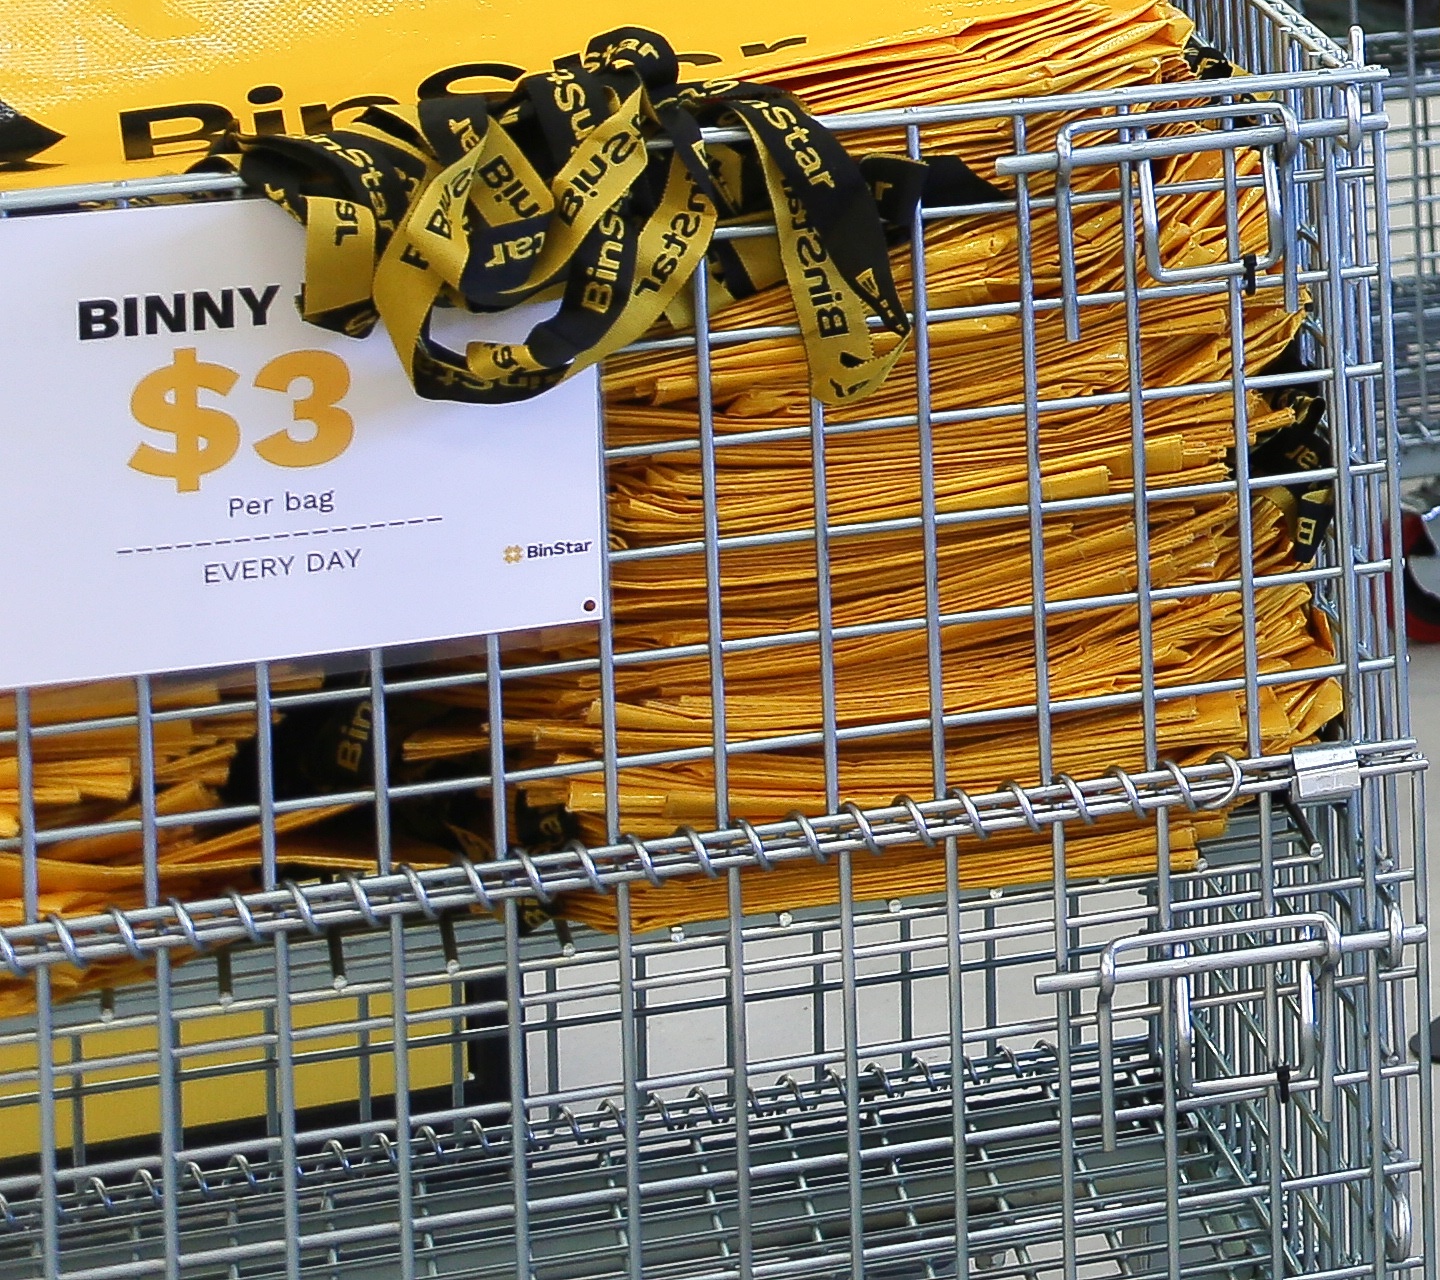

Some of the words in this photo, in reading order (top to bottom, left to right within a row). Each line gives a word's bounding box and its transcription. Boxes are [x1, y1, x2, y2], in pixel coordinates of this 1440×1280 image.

[77, 283, 281, 341] BINNY
[126, 347, 357, 494] $3
[228, 493, 274, 518] Per
[285, 490, 335, 514] bag
[203, 555, 296, 584] EVERY
[307, 548, 363, 574] DAY
[526, 539, 593, 560] BinStar
